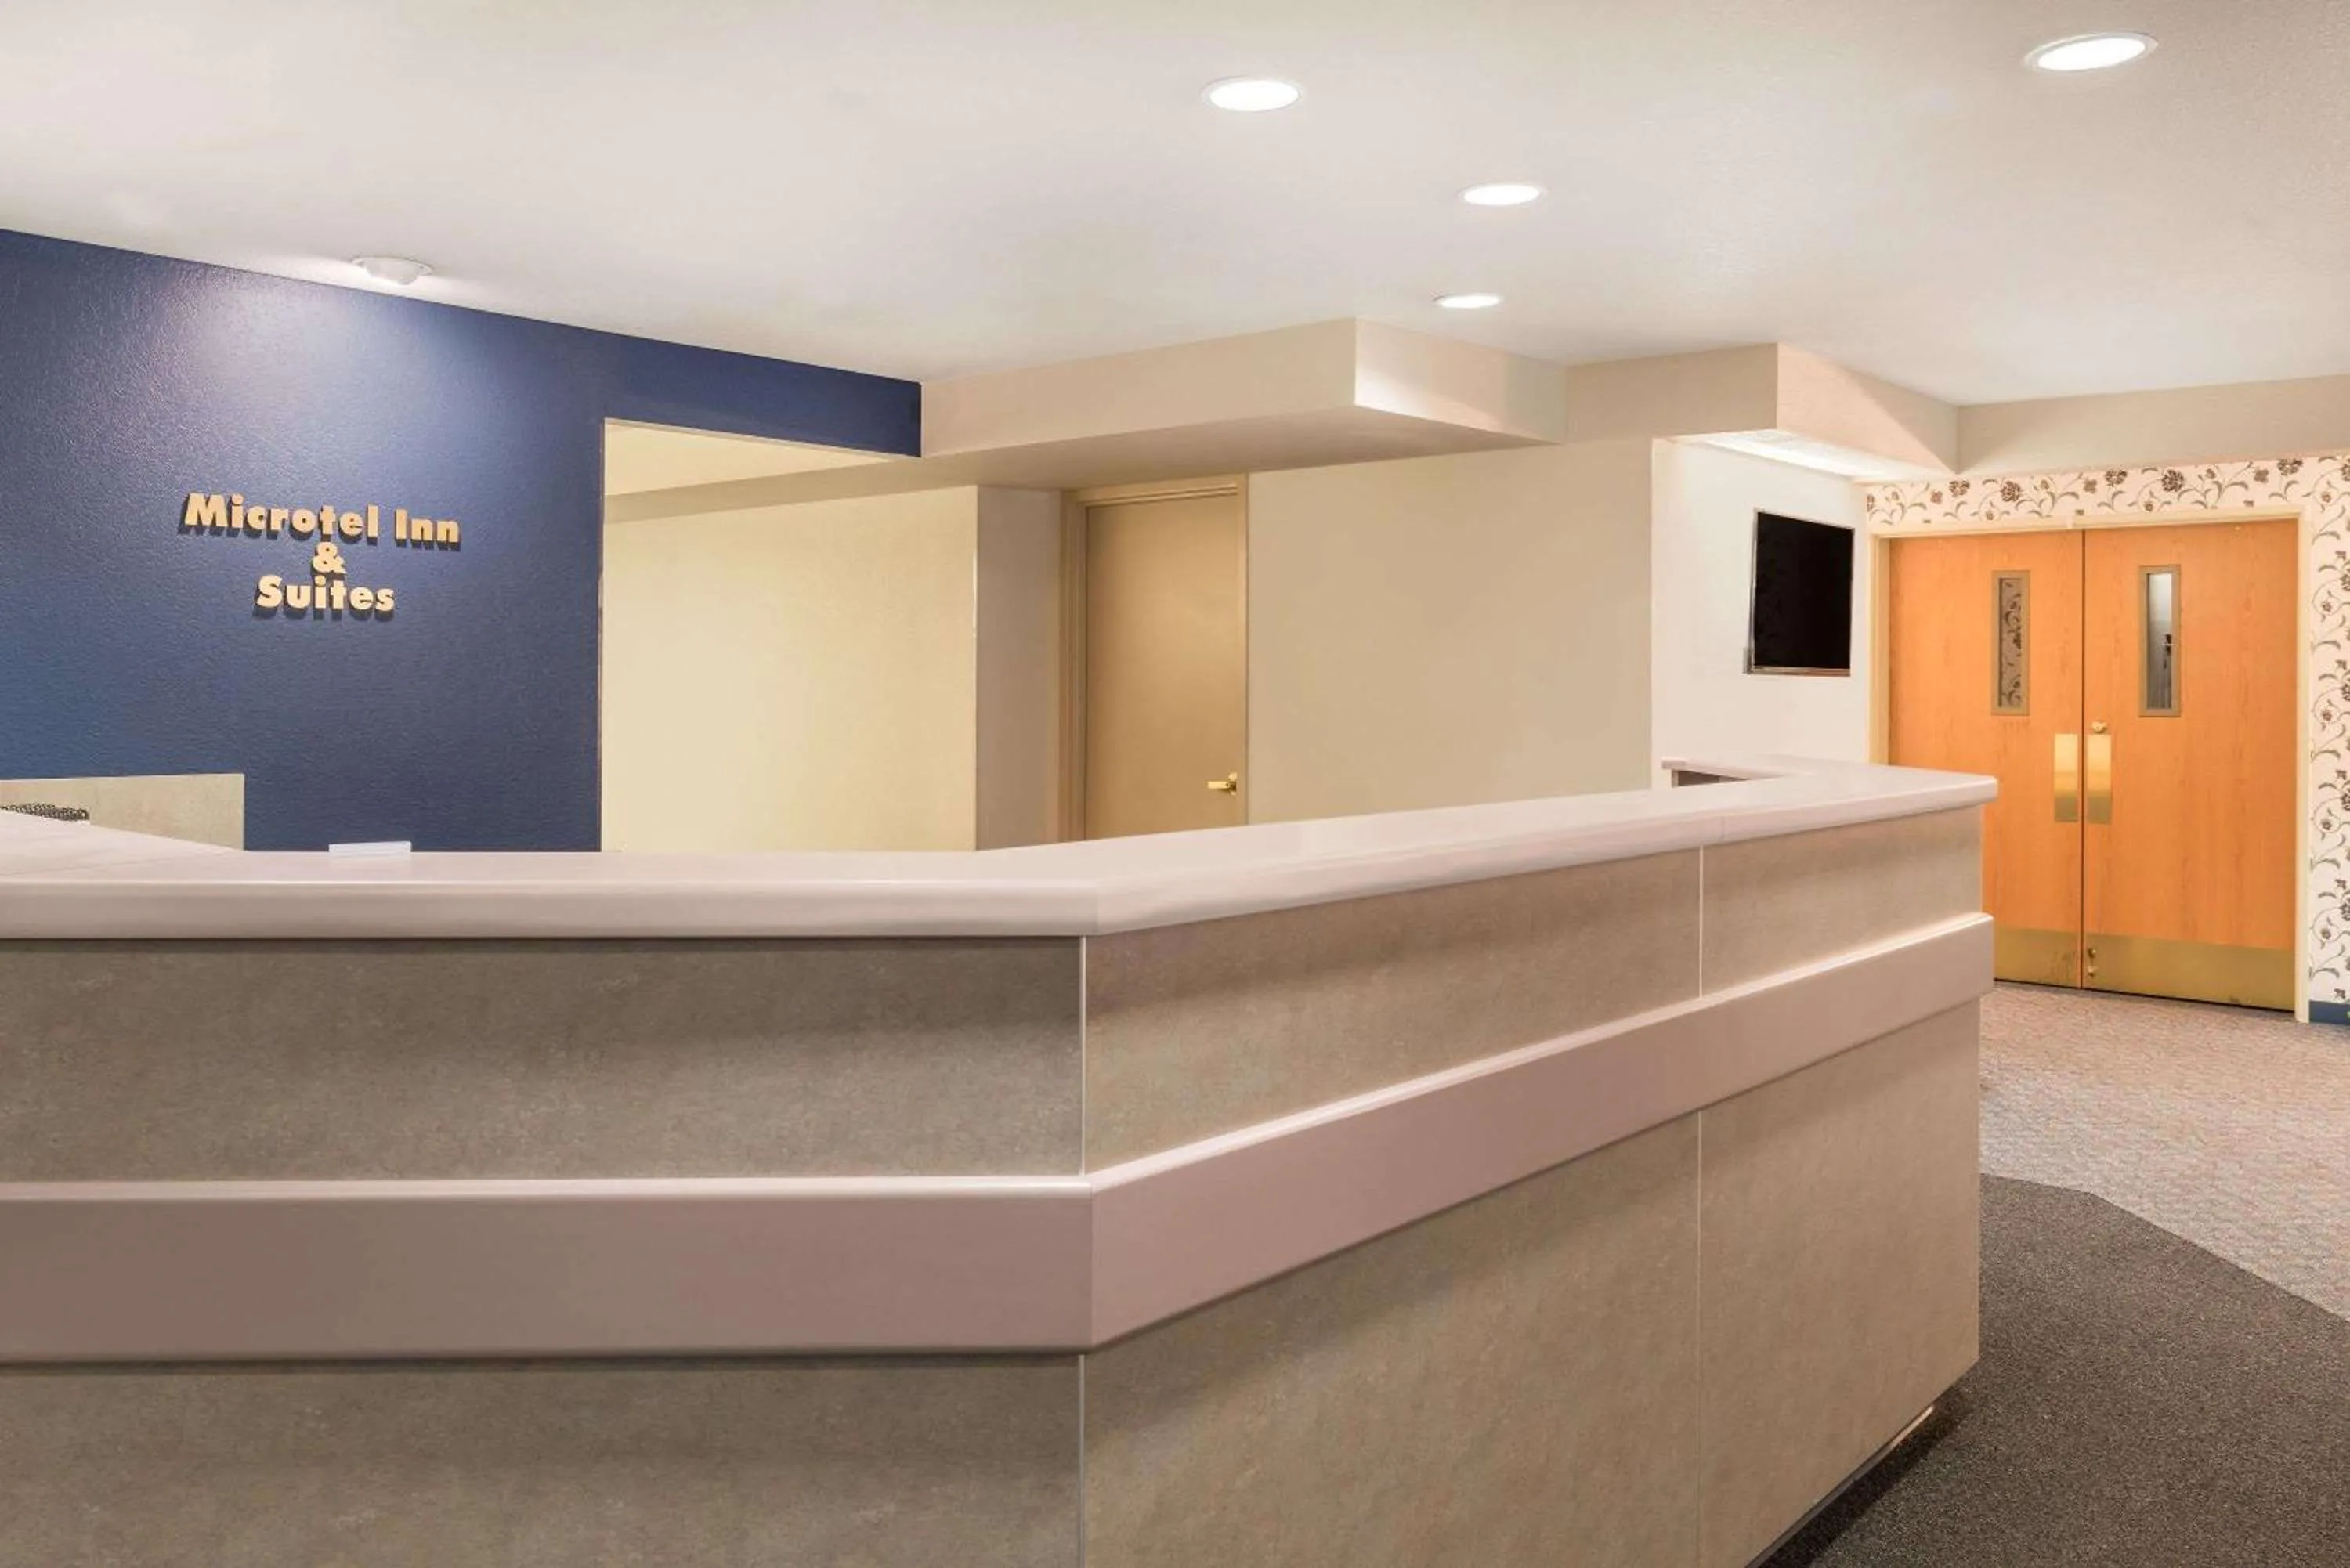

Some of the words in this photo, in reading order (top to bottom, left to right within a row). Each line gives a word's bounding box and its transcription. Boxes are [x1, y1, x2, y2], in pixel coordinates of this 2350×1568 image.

[183, 493, 379, 539] Microtel
[395, 508, 461, 544] Inn
[313, 541, 346, 574] &
[255, 574, 396, 612] Suites
